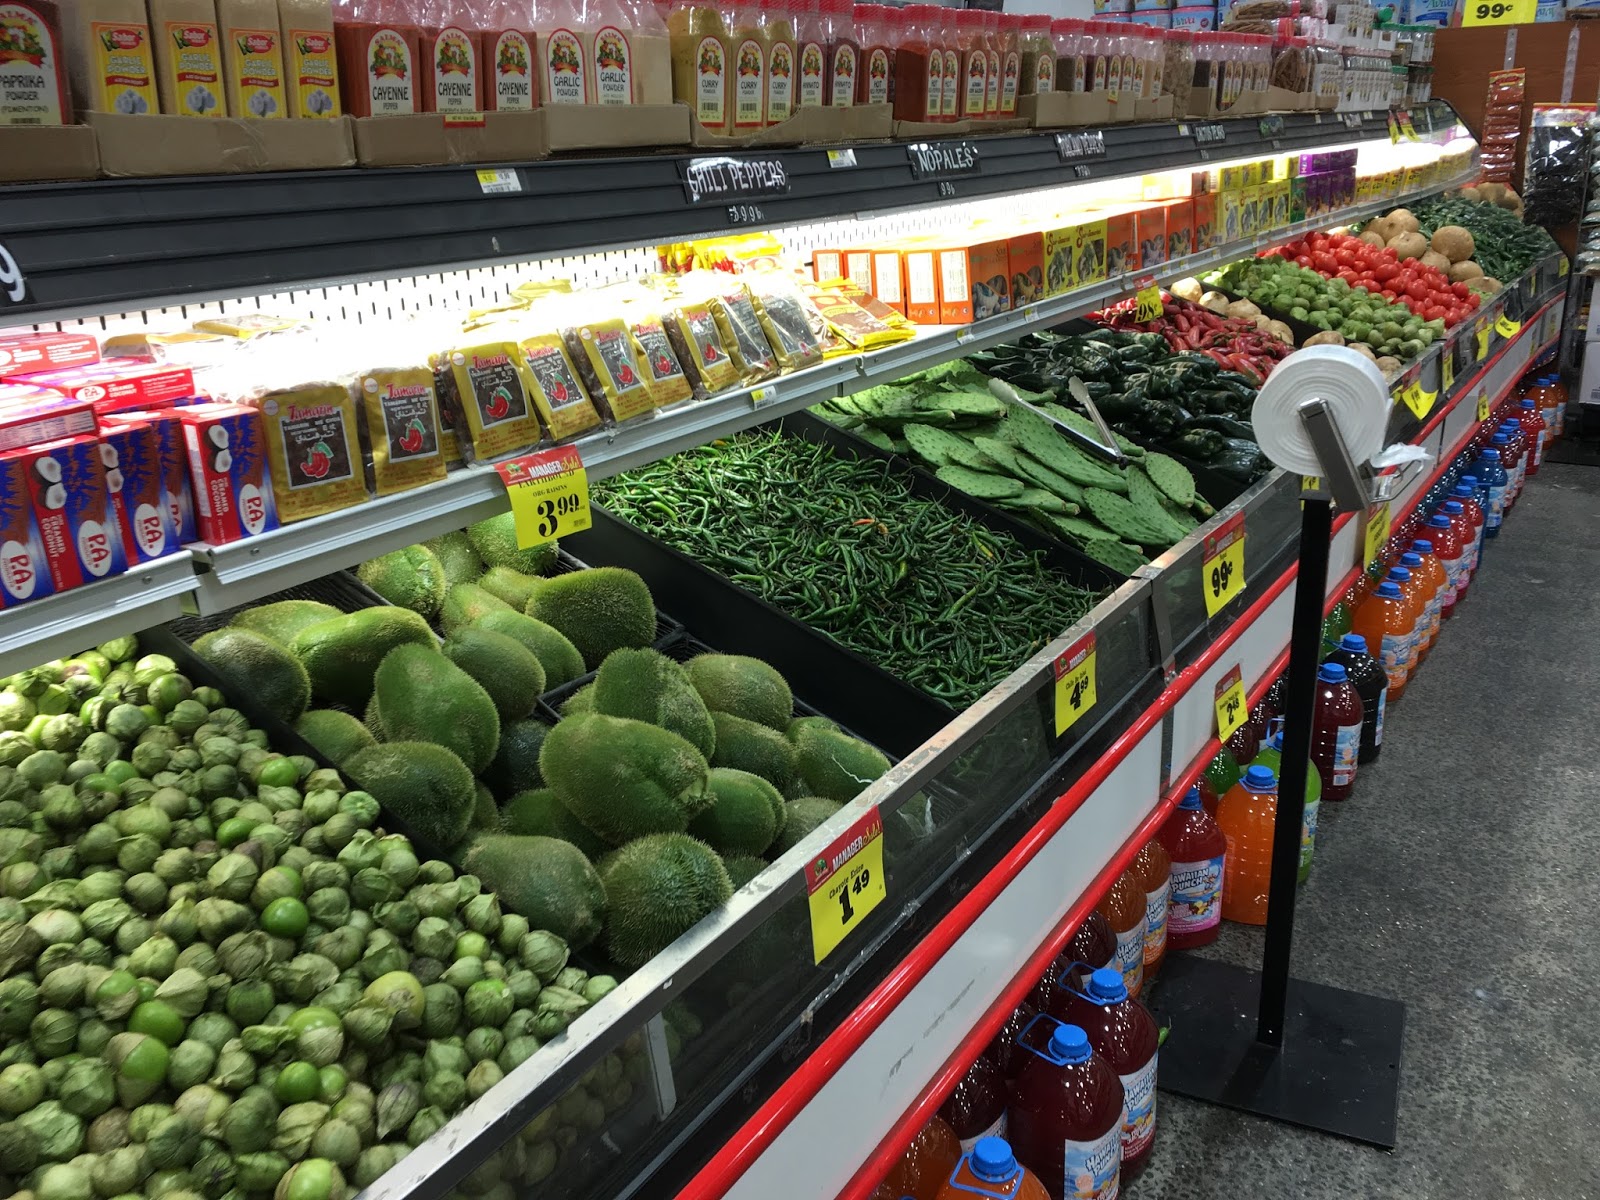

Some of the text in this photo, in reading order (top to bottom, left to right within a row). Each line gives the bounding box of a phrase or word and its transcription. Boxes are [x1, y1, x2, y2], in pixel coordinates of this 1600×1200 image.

[107, 65, 146, 74] POWDER
[179, 62, 214, 71] POWDER
[242, 67, 276, 76] POWDER
[301, 67, 332, 76] POWDER
[553, 76, 580, 87] GARLIC
[600, 71, 626, 83] GARLIC
[438, 82, 472, 97] CAYENNE
[498, 82, 529, 96] CAYENNE
[602, 83, 624, 92] POWDER
[701, 79, 719, 88] CURRY
[740, 81, 757, 90] CURRY
[772, 81, 787, 90] CURRY
[873, 80, 883, 88] HOT
[5, 91, 39, 101] POWDER
[372, 86, 409, 101] CAYENNE
[556, 88, 579, 97] POWDER
[383, 102, 399, 110] PEPPER
[447, 97, 462, 106] PEPPER
[917, 147, 974, 172] NOPALES
[727, 160, 786, 191] PEPPERS
[528, 460, 563, 479] MANAGER
[217, 478, 229, 513] CREAMED
[532, 484, 568, 498] ORG RAISINS
[210, 479, 224, 517] COCONUT
[41, 517, 60, 558] COCONUT
[50, 515, 66, 554] CREAMED
[832, 835, 863, 872] MANAGER
[829, 876, 849, 899] Chayote
[1171, 876, 1204, 893] PUNCH
